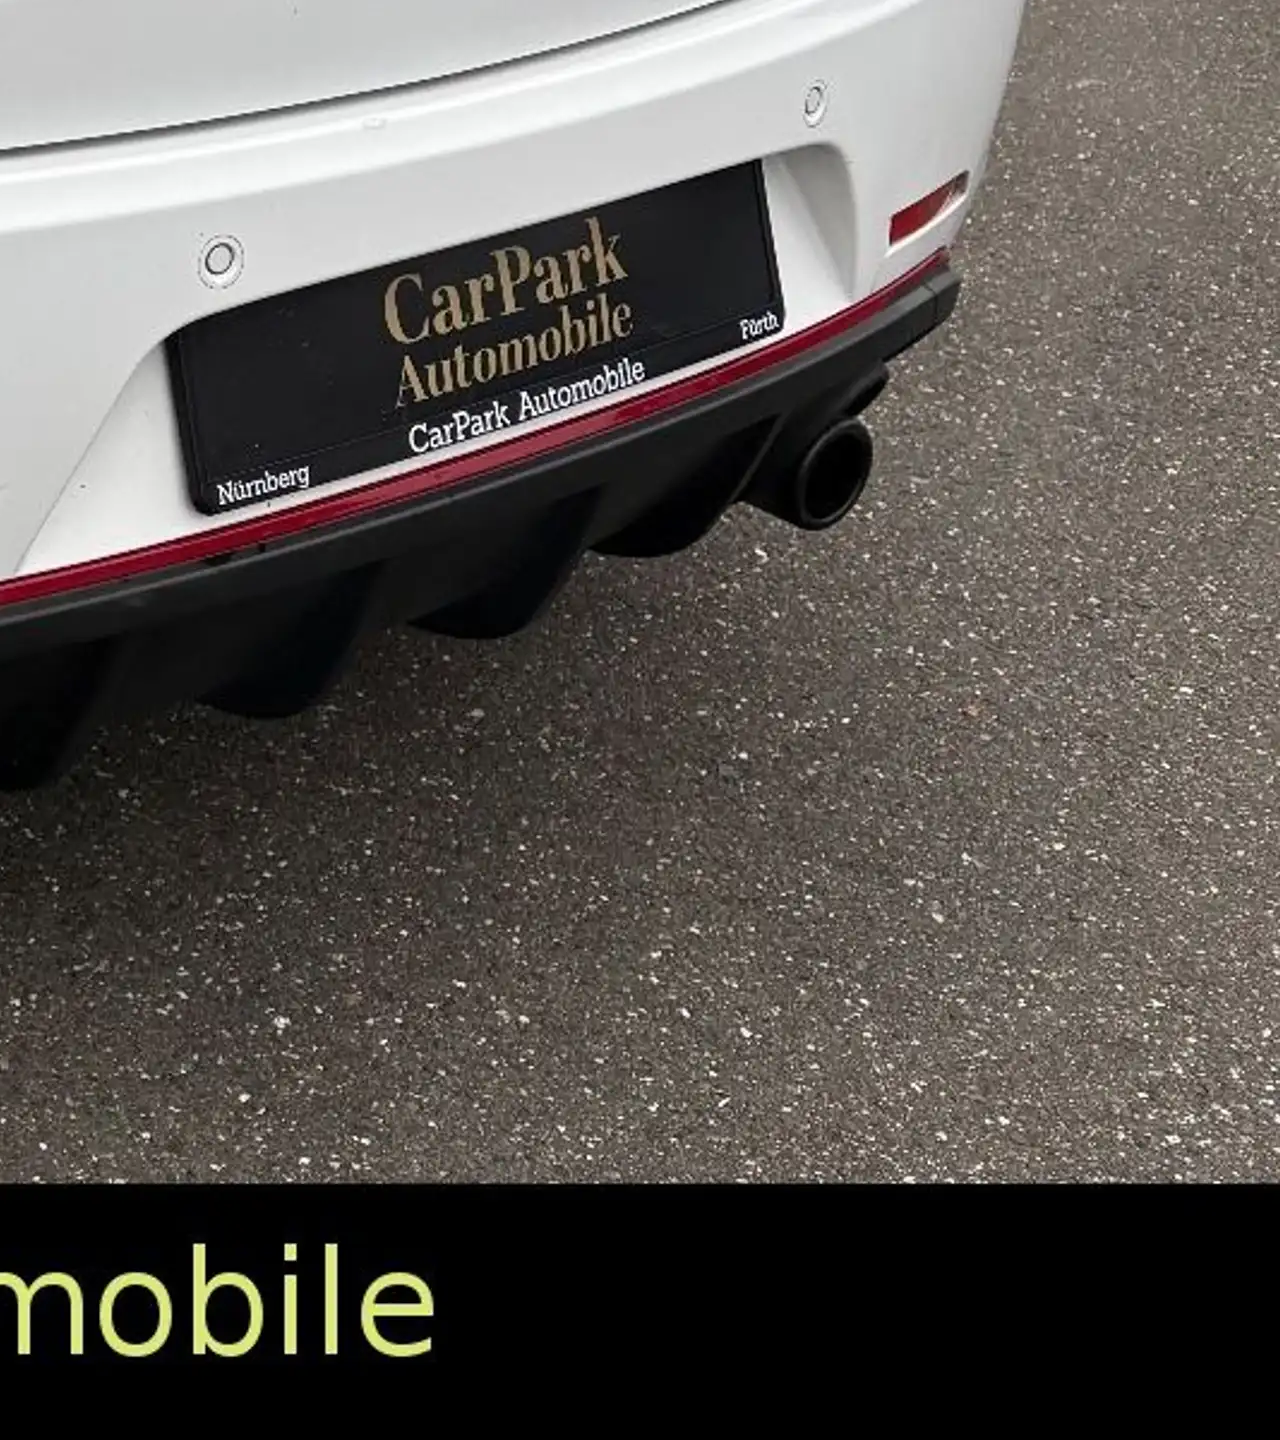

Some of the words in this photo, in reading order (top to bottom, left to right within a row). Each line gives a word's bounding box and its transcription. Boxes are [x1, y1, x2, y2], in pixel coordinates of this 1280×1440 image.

[384, 216, 628, 345] CarPark
[740, 310, 780, 340] Fürth
[395, 293, 634, 409] Automobile
[408, 401, 511, 453] CarPark
[519, 358, 646, 422] Automobile
[216, 465, 310, 505] Nürnberg
